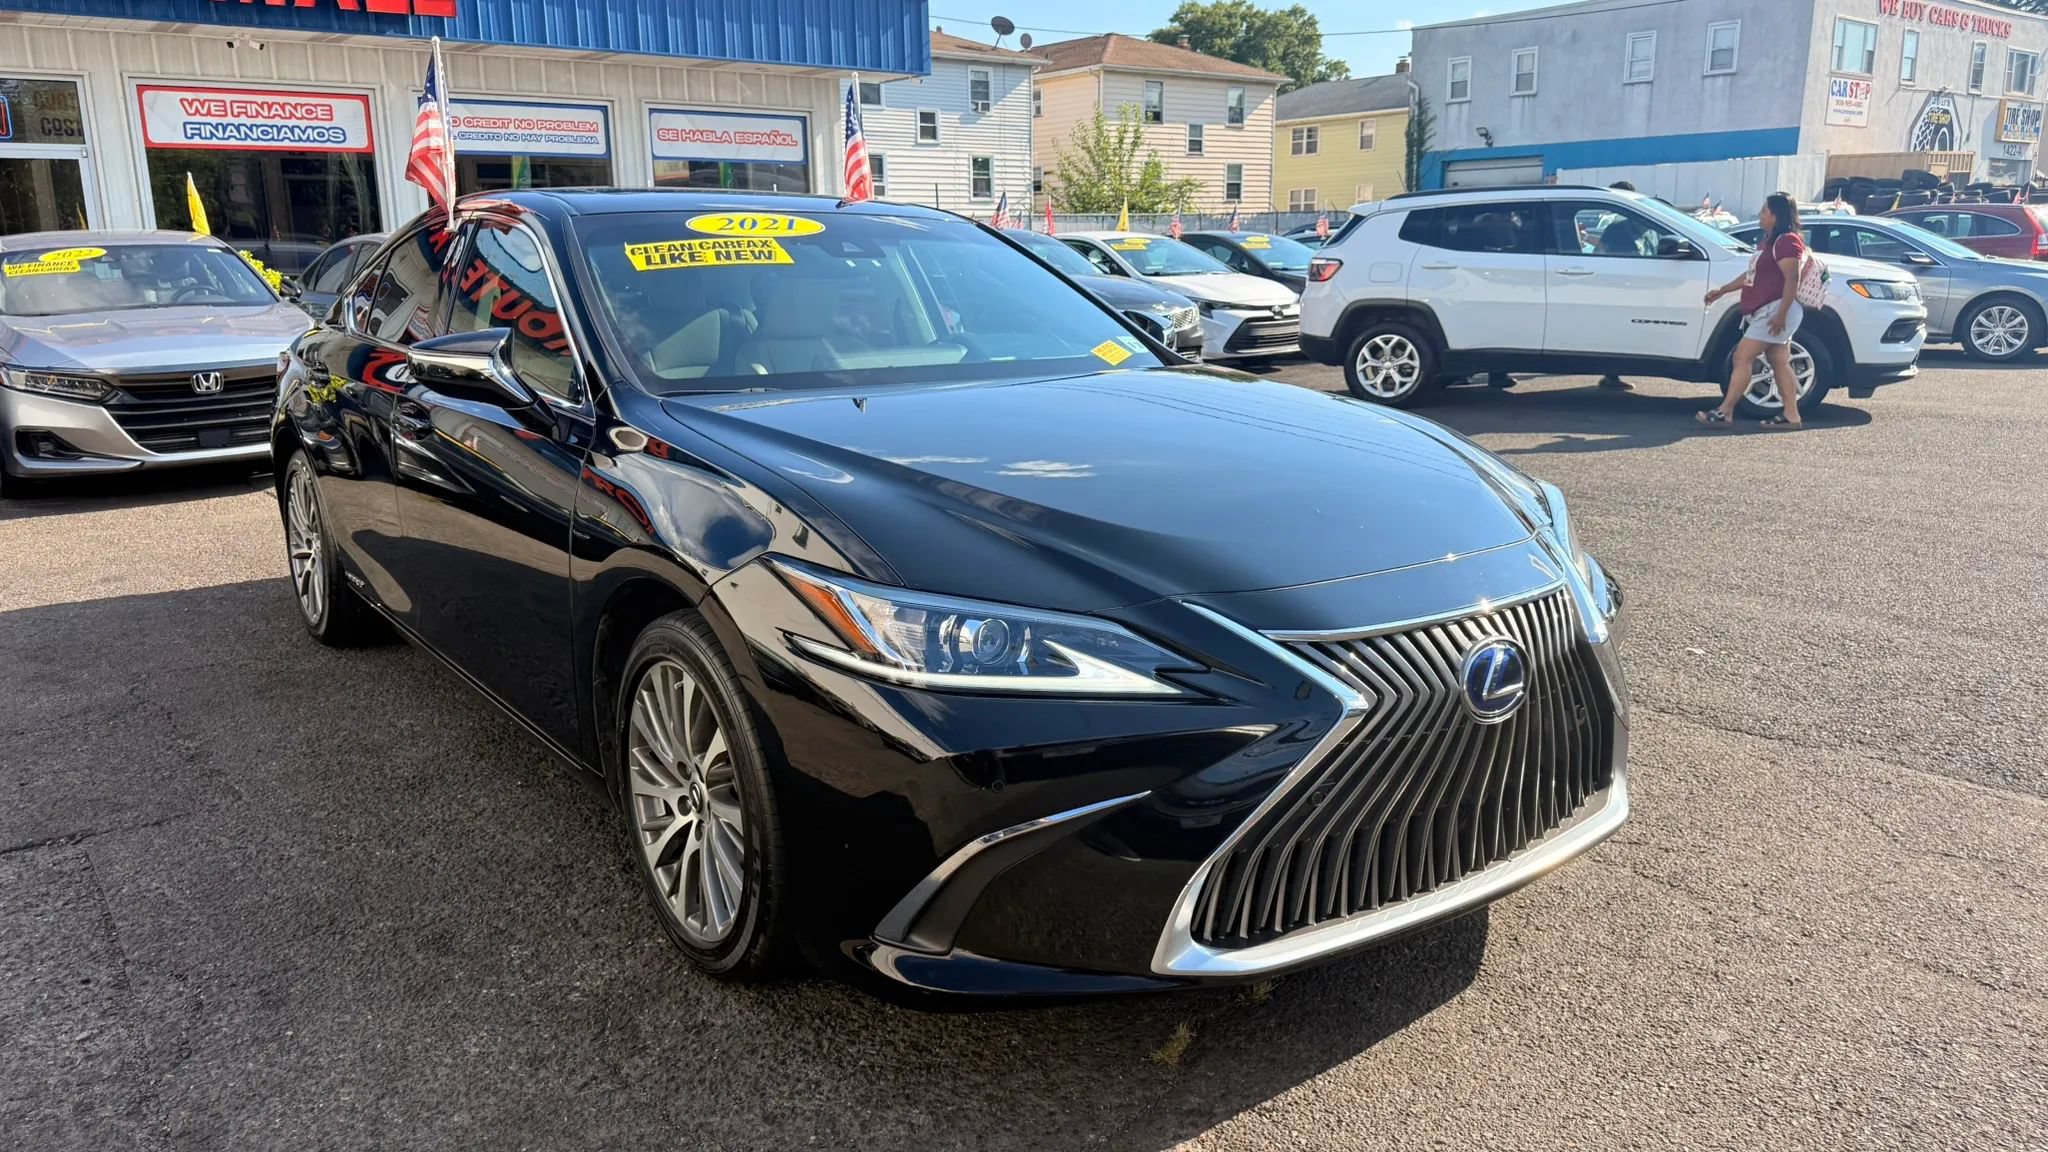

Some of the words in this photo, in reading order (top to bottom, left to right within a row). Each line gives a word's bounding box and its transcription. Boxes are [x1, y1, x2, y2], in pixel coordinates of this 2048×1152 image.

[1879, 0, 1898, 16] WE
[1901, 1, 1926, 21] BUY
[1929, 6, 1959, 28] CARS
[1972, 15, 2012, 38] TRUCKS
[1831, 80, 1848, 97] CAR
[180, 98, 227, 116] WE
[230, 100, 333, 121] FINANCE
[2005, 107, 2020, 125] TIRE
[2021, 109, 2040, 127] SHOP
[183, 122, 347, 143] FINANCIAMOS
[464, 117, 511, 128] CREDIT
[513, 119, 534, 129] NO
[537, 120, 598, 132] PROBLEM
[458, 131, 502, 142] CREDITO
[504, 133, 520, 142] NO
[521, 134, 542, 143] HAY
[545, 135, 599, 144] PROBLEMA
[657, 128, 680, 141] SE
[682, 129, 732, 144] HABLA
[734, 130, 798, 146] ESPAÑOL
[717, 217, 798, 231] 2021
[631, 242, 695, 256] CLEAN
[698, 239, 774, 251] CARFAX
[645, 252, 703, 267] LIKE
[715, 249, 775, 262] NEW
